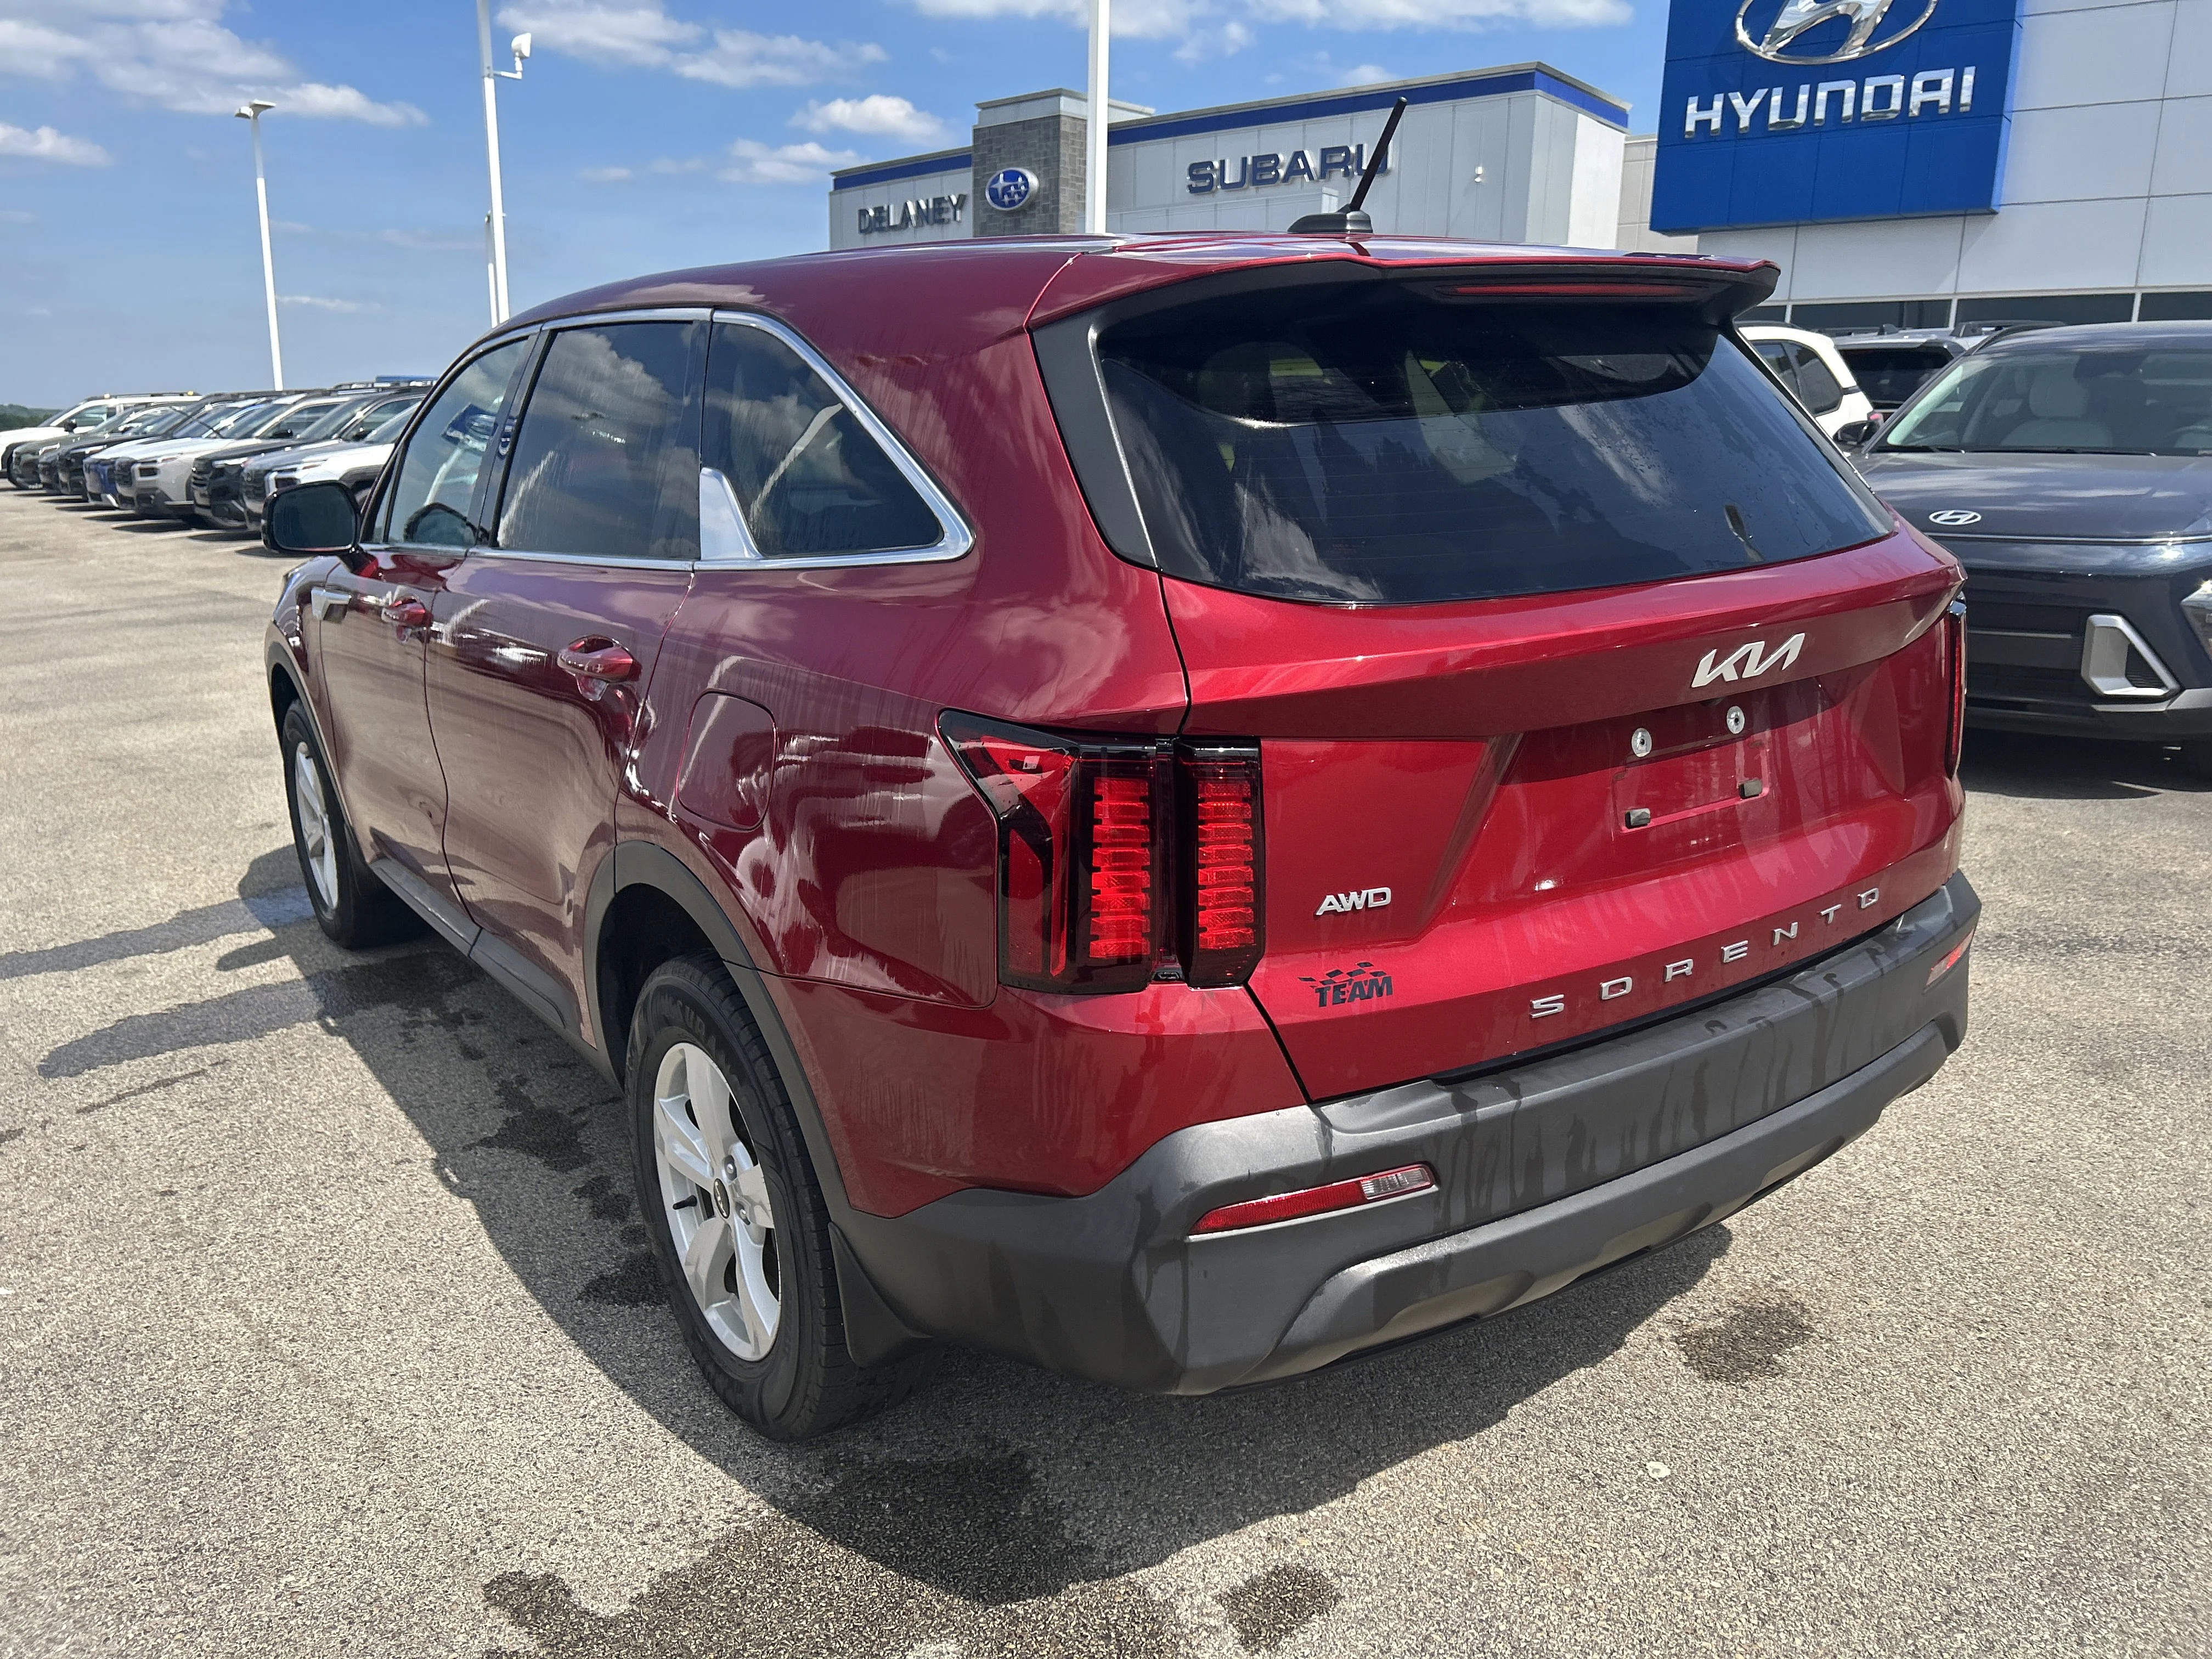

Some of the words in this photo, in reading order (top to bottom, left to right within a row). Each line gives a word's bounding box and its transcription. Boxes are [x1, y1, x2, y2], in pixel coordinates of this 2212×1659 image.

[1684, 66, 1976, 138] HYUNDAI
[858, 194, 967, 234] DELANEY
[1691, 633, 1805, 688] KIA
[1316, 887, 1392, 916] AWD
[1529, 887, 1880, 1019] SORENTO
[1314, 975, 1393, 1007] TEAM
